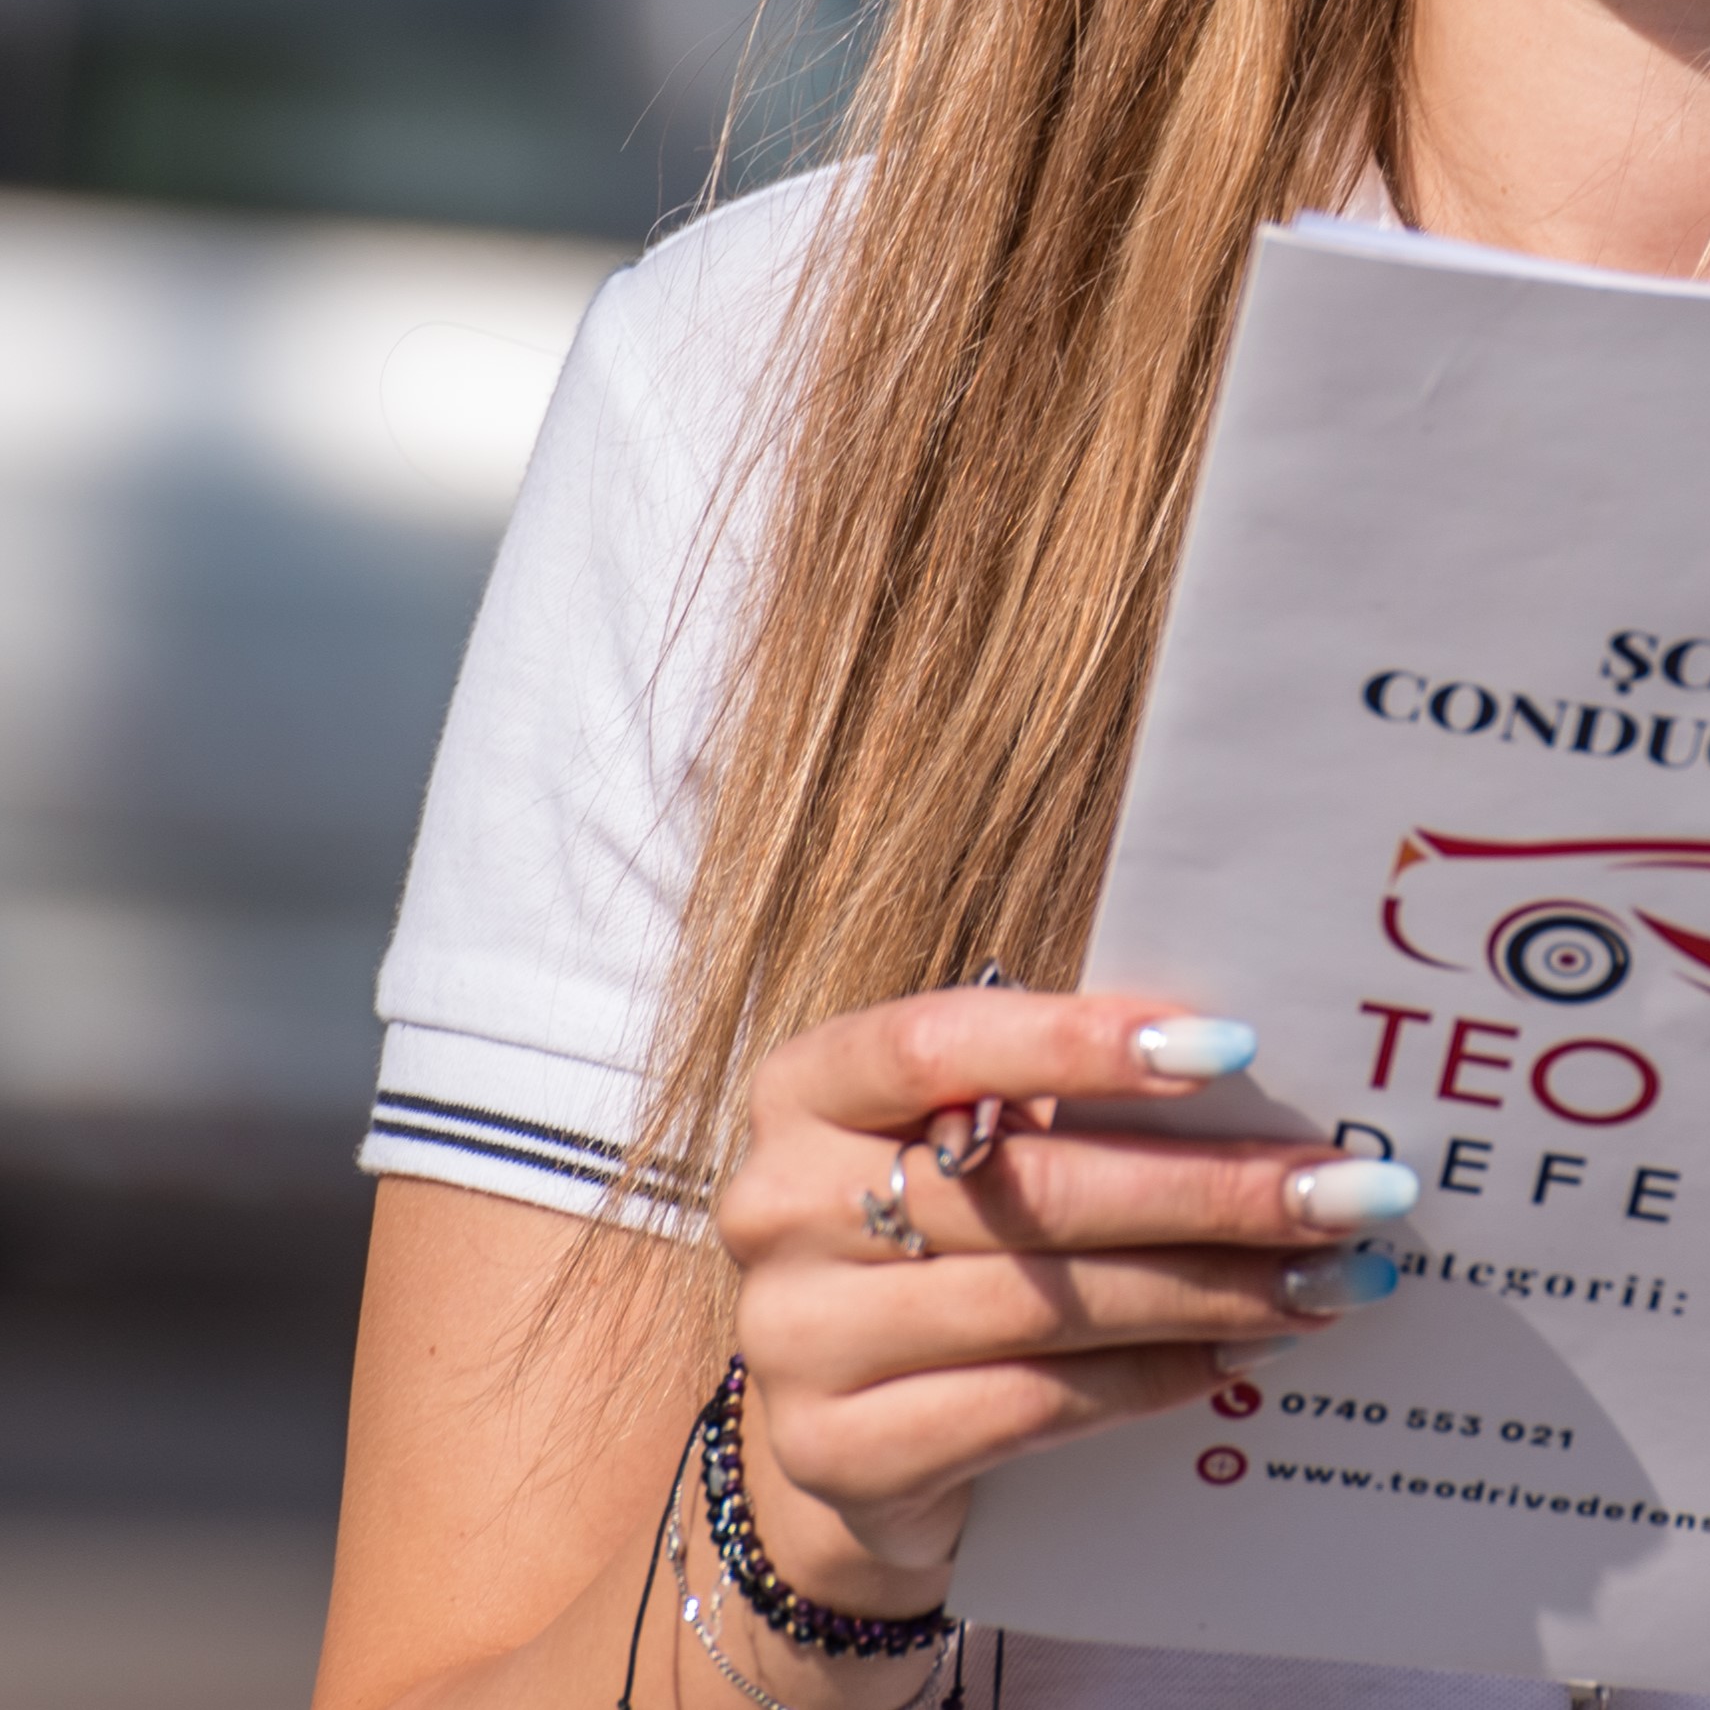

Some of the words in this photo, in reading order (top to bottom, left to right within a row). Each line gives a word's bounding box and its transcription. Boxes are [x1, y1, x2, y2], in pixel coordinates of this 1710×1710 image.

[1358, 1000, 1662, 1129] TEO
[1279, 1391, 1390, 1426] 0740
[1404, 1406, 1483, 1439] 553
[1498, 1420, 1575, 1451] 021
